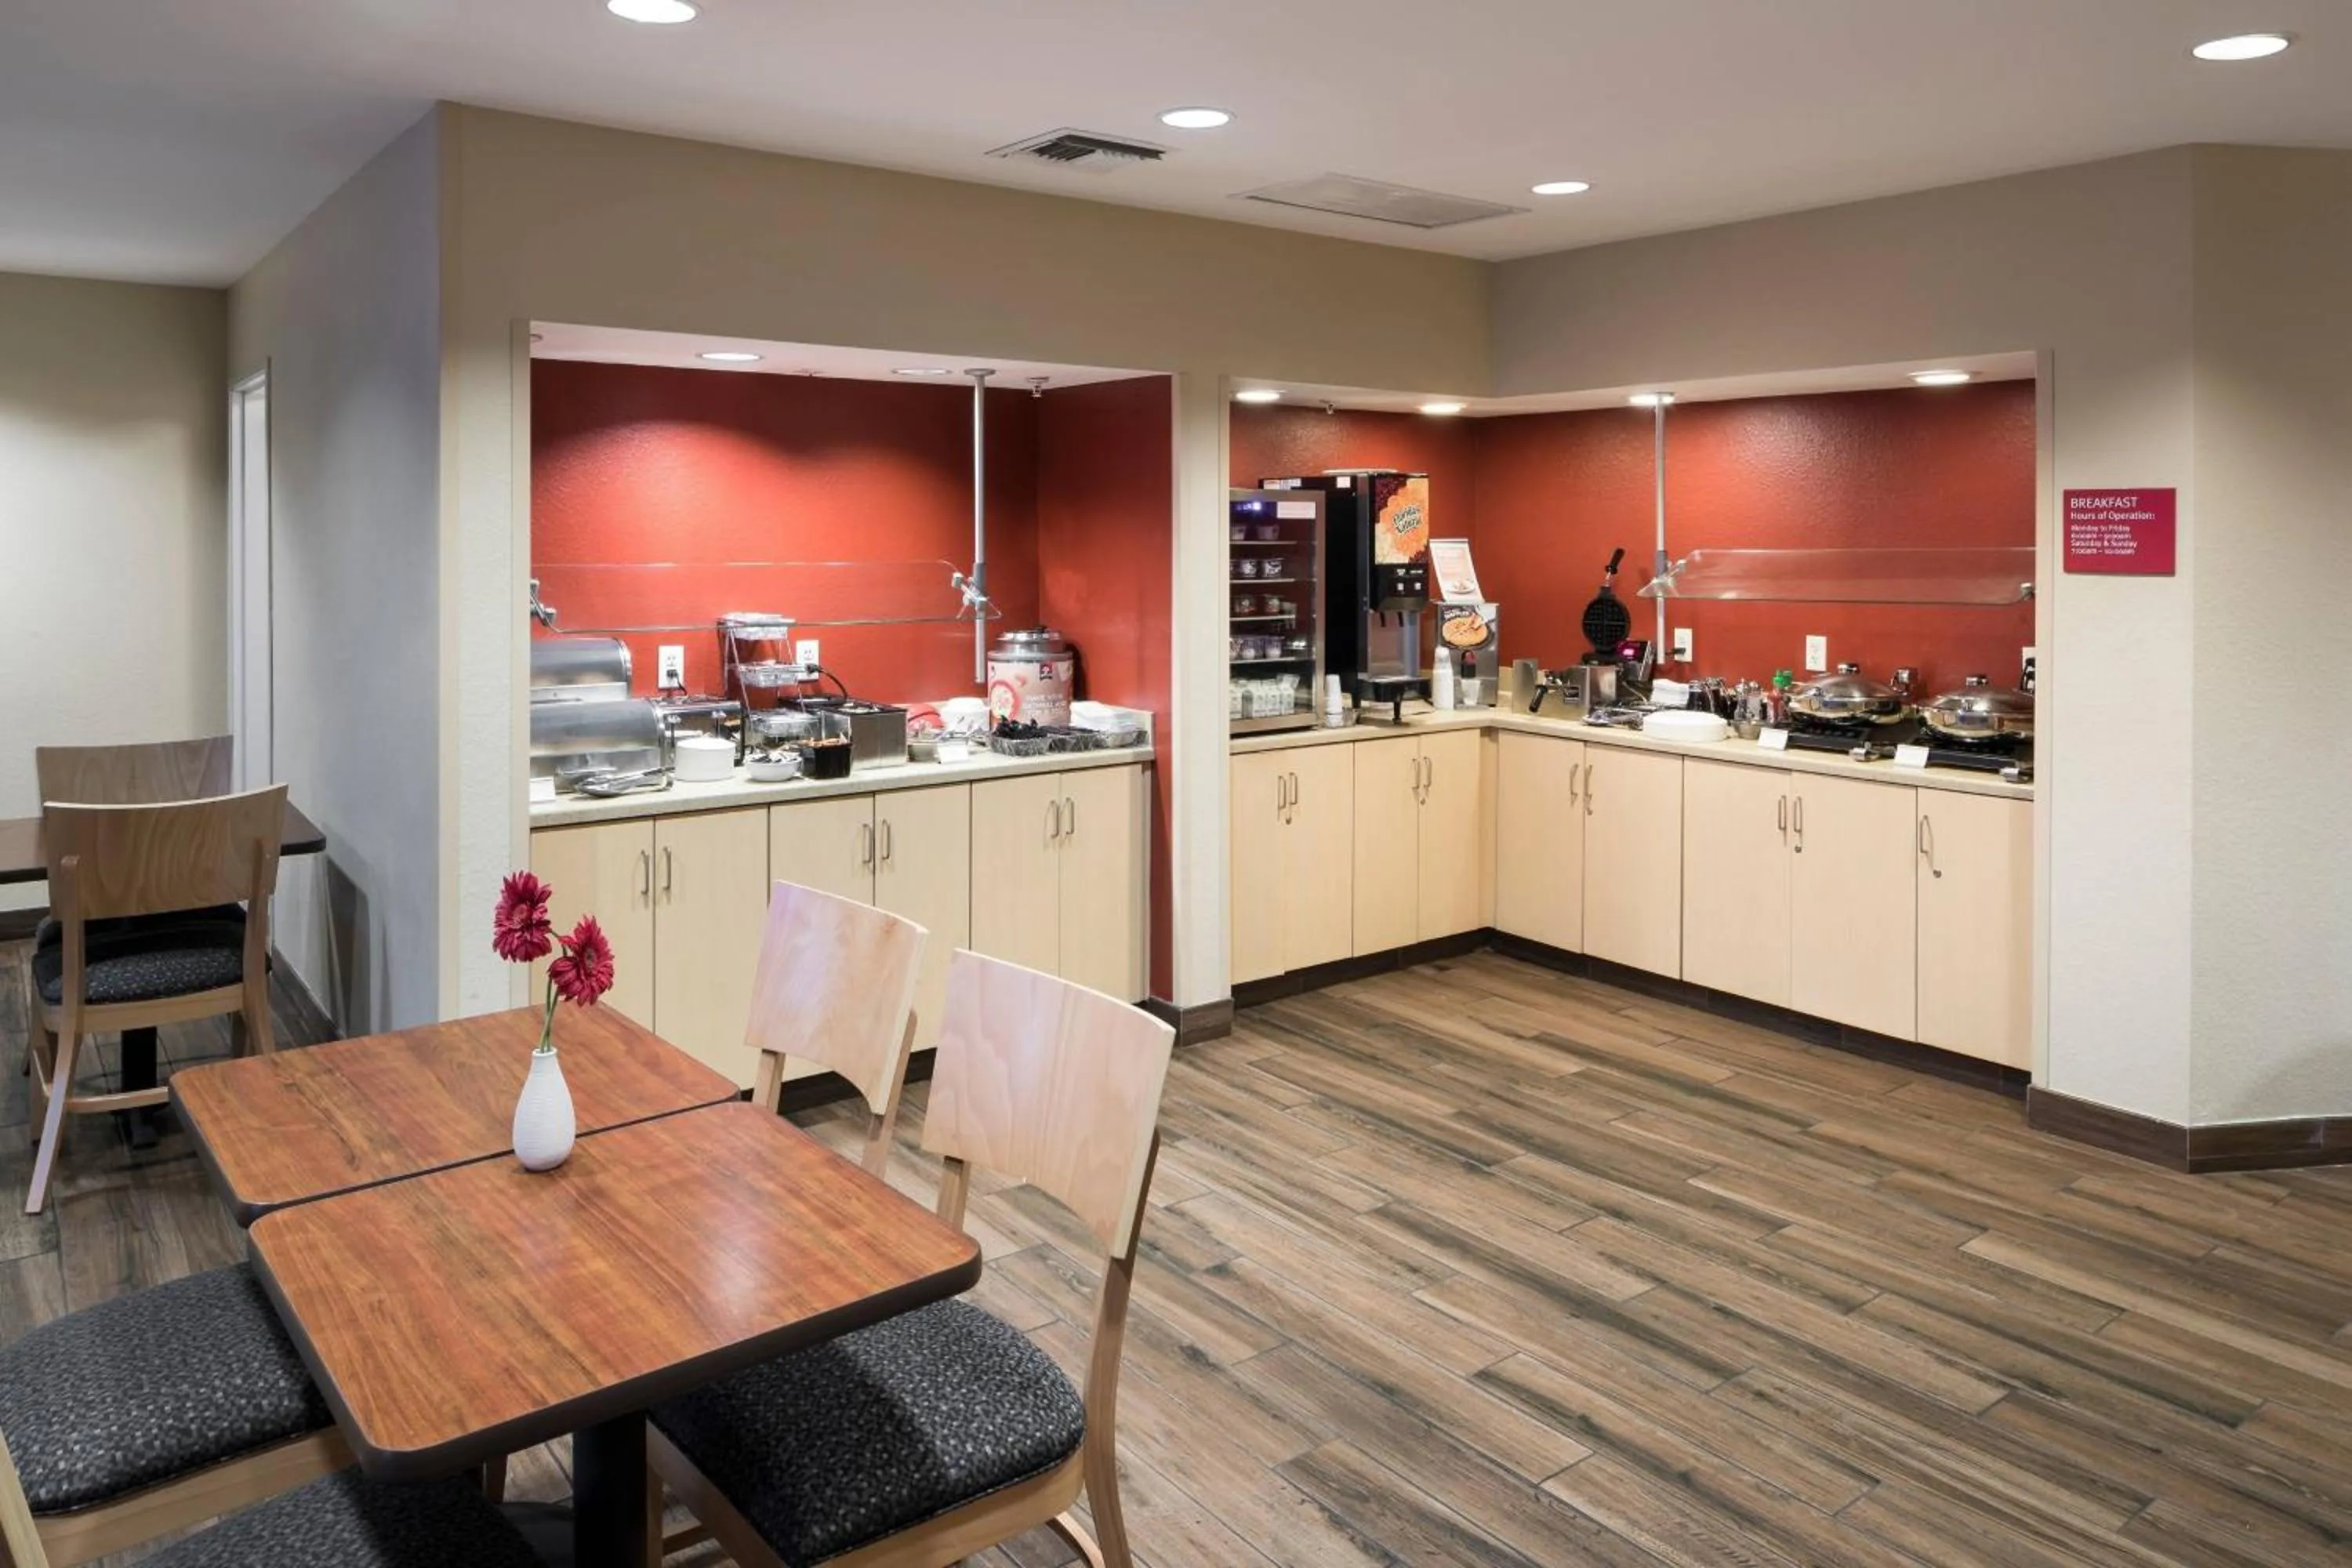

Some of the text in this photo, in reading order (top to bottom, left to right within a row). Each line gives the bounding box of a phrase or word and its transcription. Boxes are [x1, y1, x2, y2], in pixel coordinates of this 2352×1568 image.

[2071, 497, 2137, 509] BREAKFAST
[2071, 511, 2155, 521] Hours of Operation:
